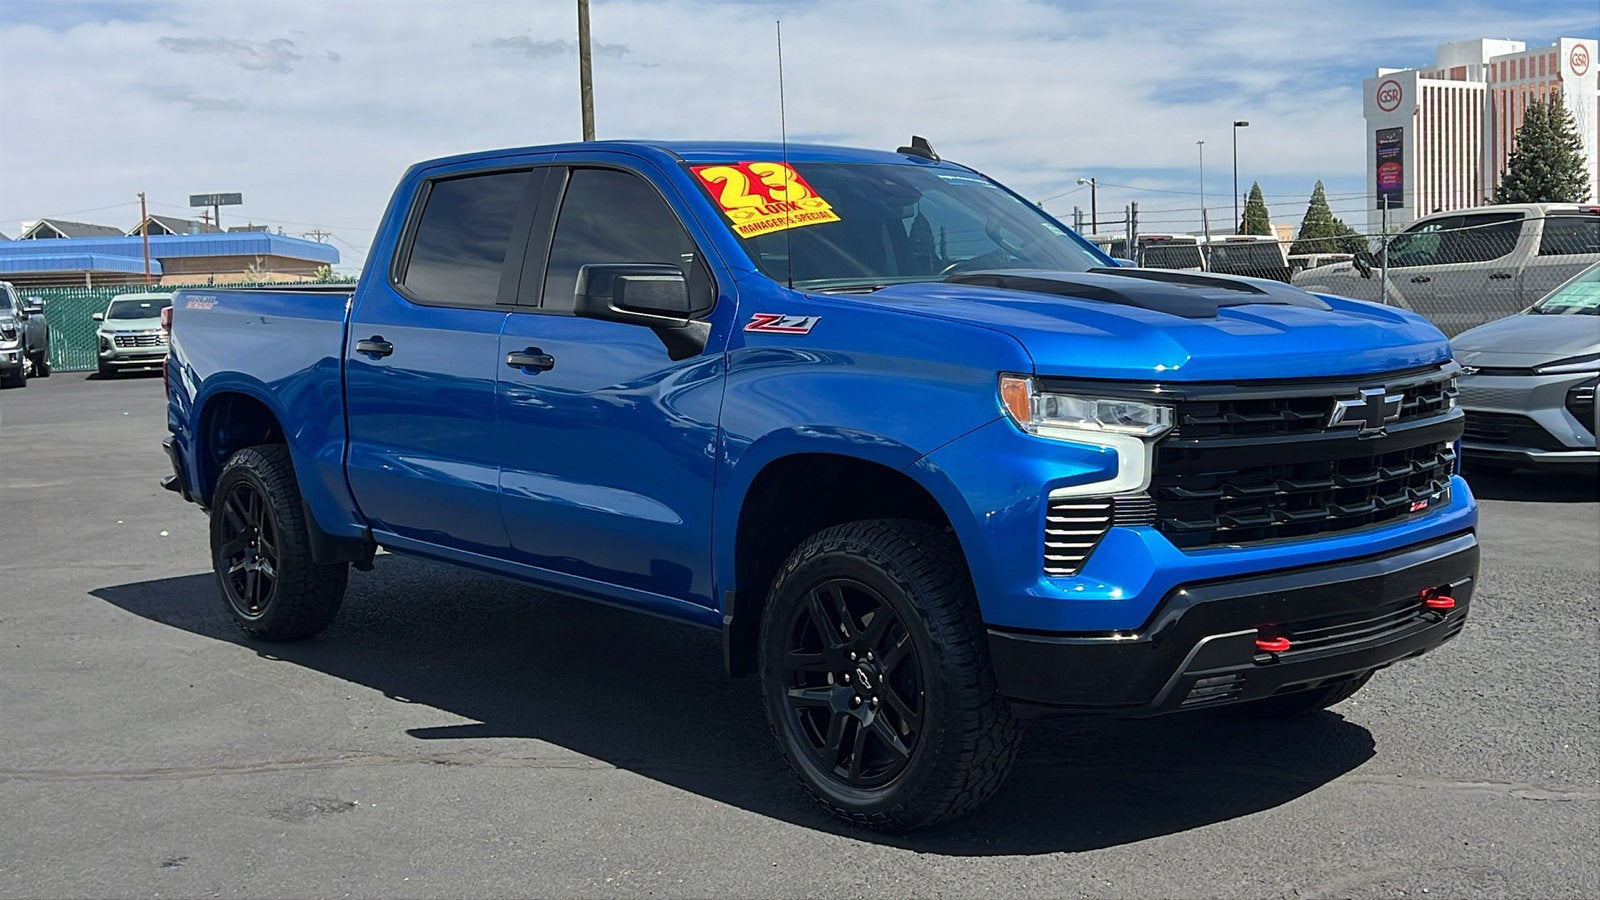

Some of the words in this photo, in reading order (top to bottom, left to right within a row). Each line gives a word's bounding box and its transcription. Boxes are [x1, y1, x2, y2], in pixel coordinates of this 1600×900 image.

[1571, 53, 1587, 67] GSR
[1380, 89, 1399, 103] GSR
[699, 162, 812, 210] 23
[753, 201, 801, 216] LOOK
[797, 210, 833, 223] SPECIAL
[743, 313, 821, 335] Z71
